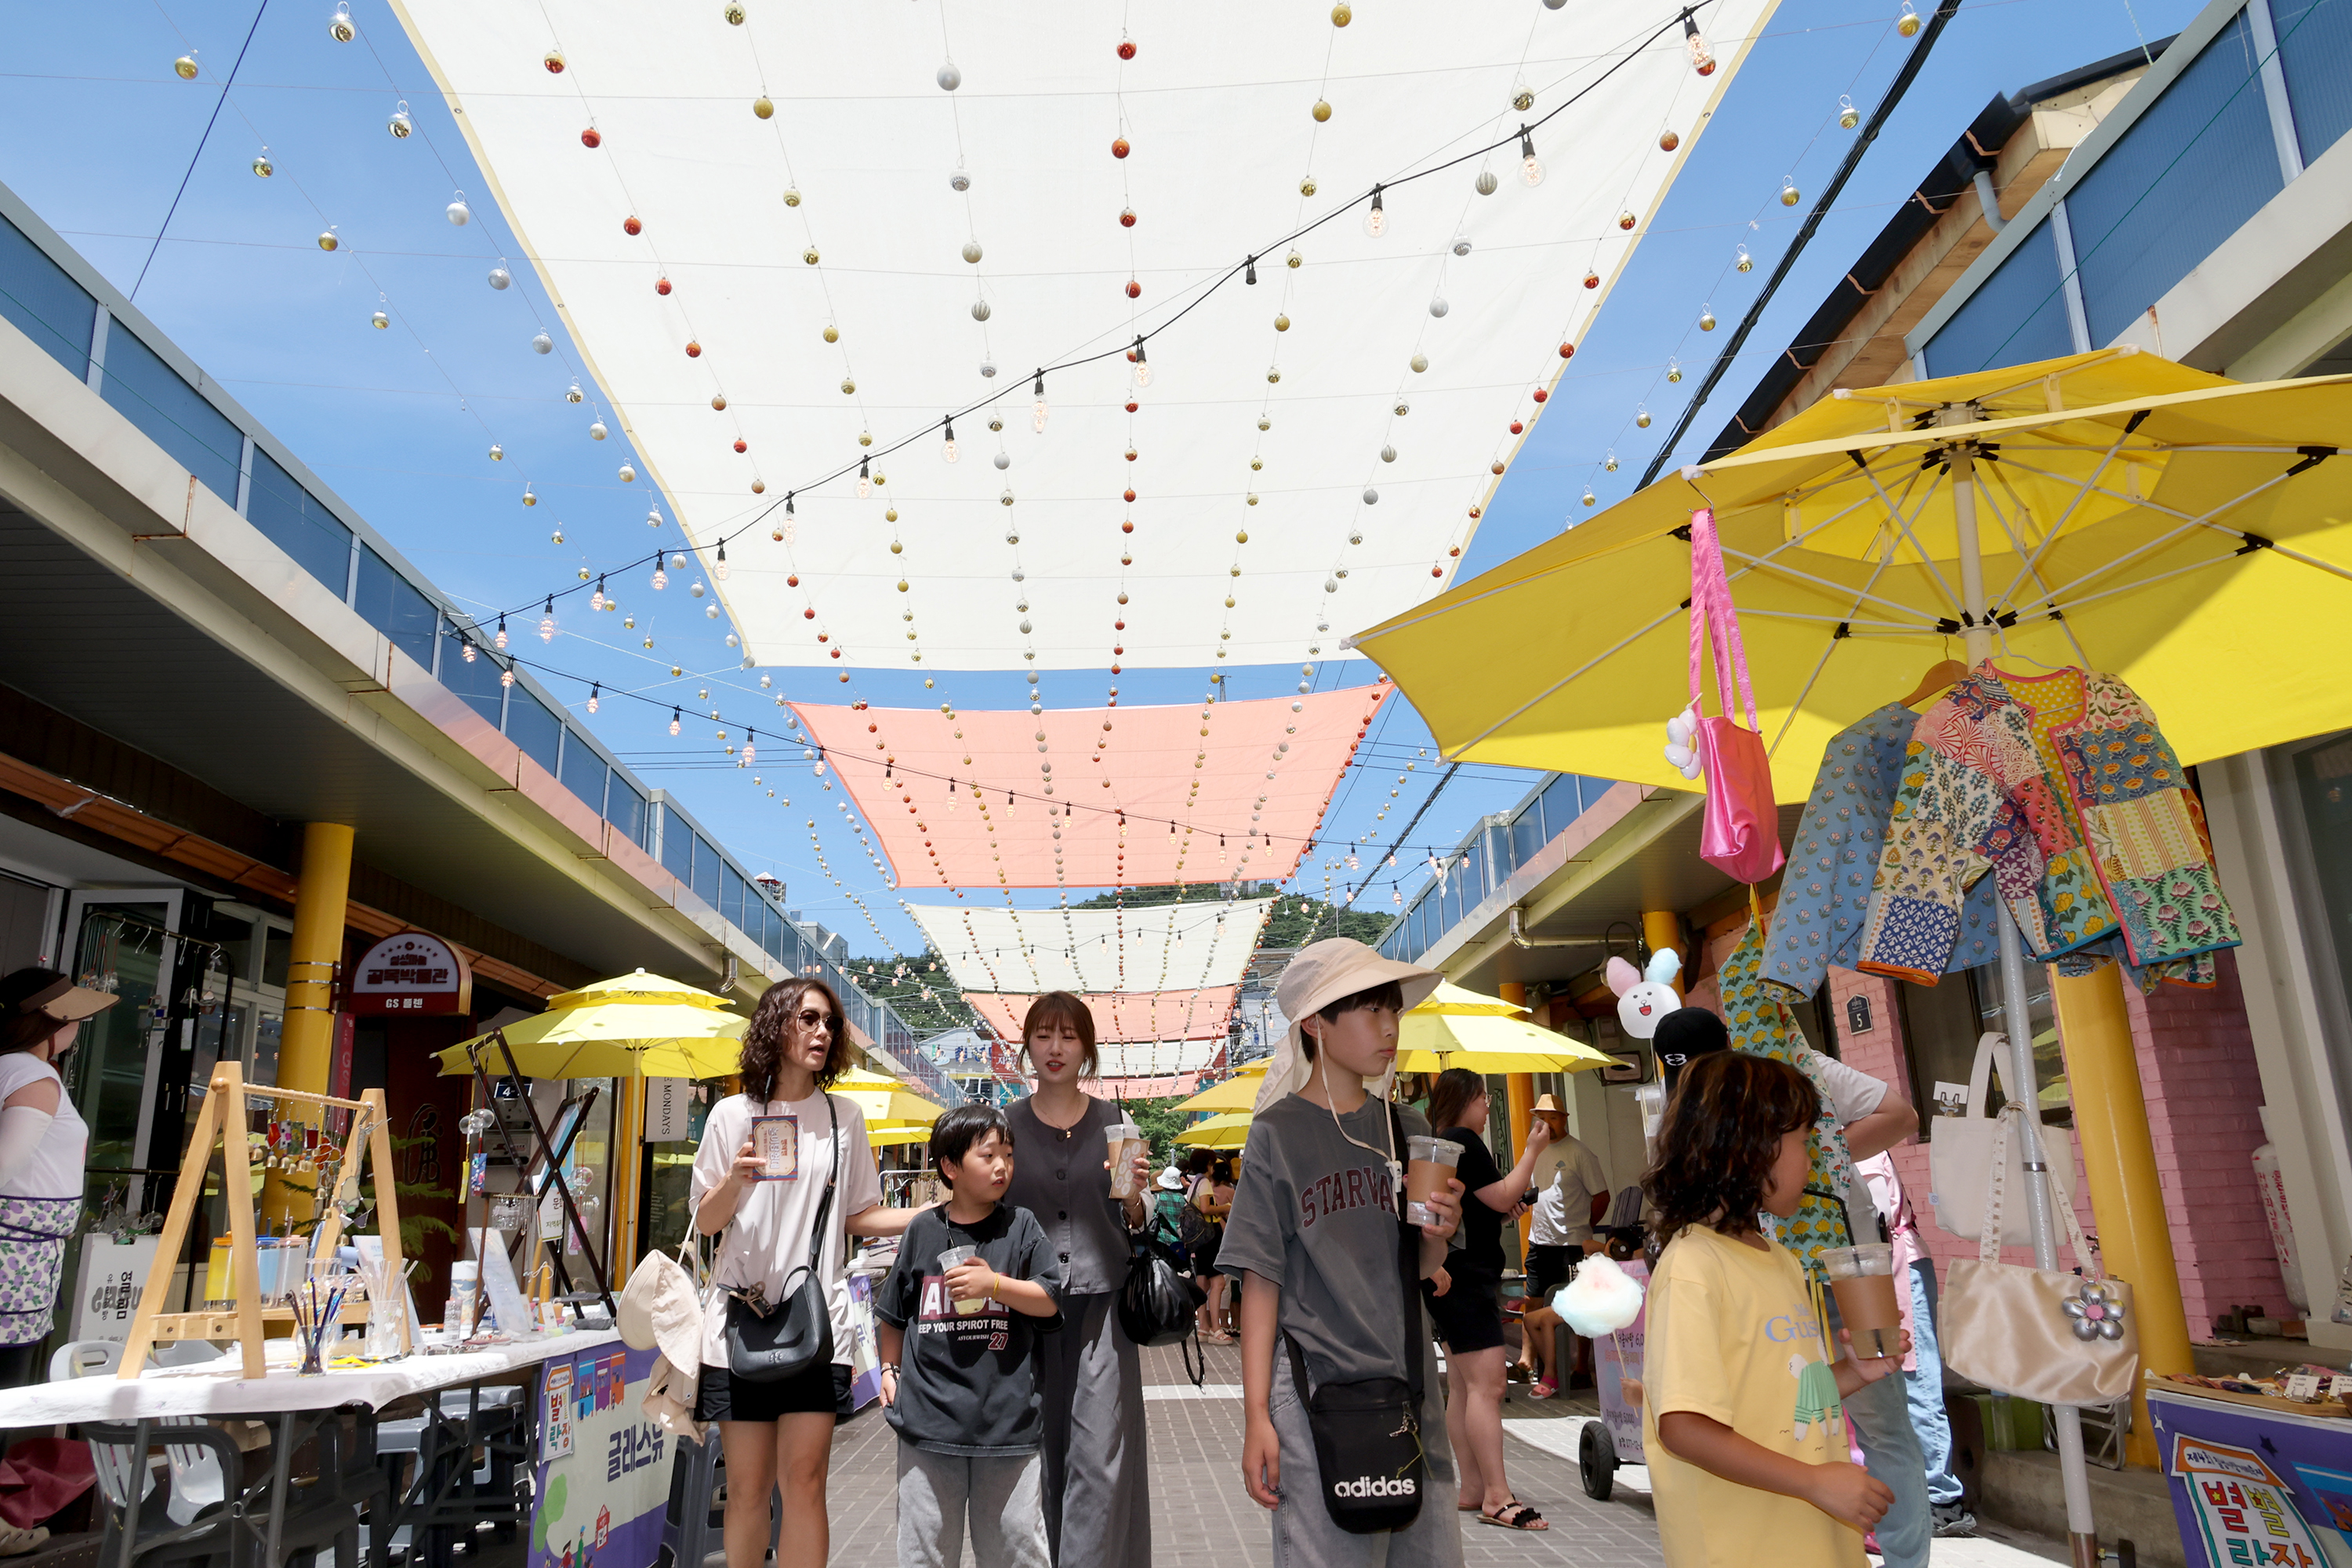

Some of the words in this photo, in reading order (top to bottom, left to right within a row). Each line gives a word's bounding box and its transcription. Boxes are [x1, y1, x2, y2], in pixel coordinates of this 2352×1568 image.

[367, 968, 449, 985] 골목박물관
[385, 998, 399, 1008] GS
[1856, 1013, 1863, 1028] 5
[662, 1084, 672, 1135] MONDAYS
[918, 1323, 932, 1334] EEP
[933, 1322, 955, 1334] YOUR
[956, 1319, 989, 1331] SPIROT
[991, 1319, 1008, 1330] FREE
[608, 1421, 664, 1483] 글래스유
[1334, 1475, 1416, 1497] adidas
